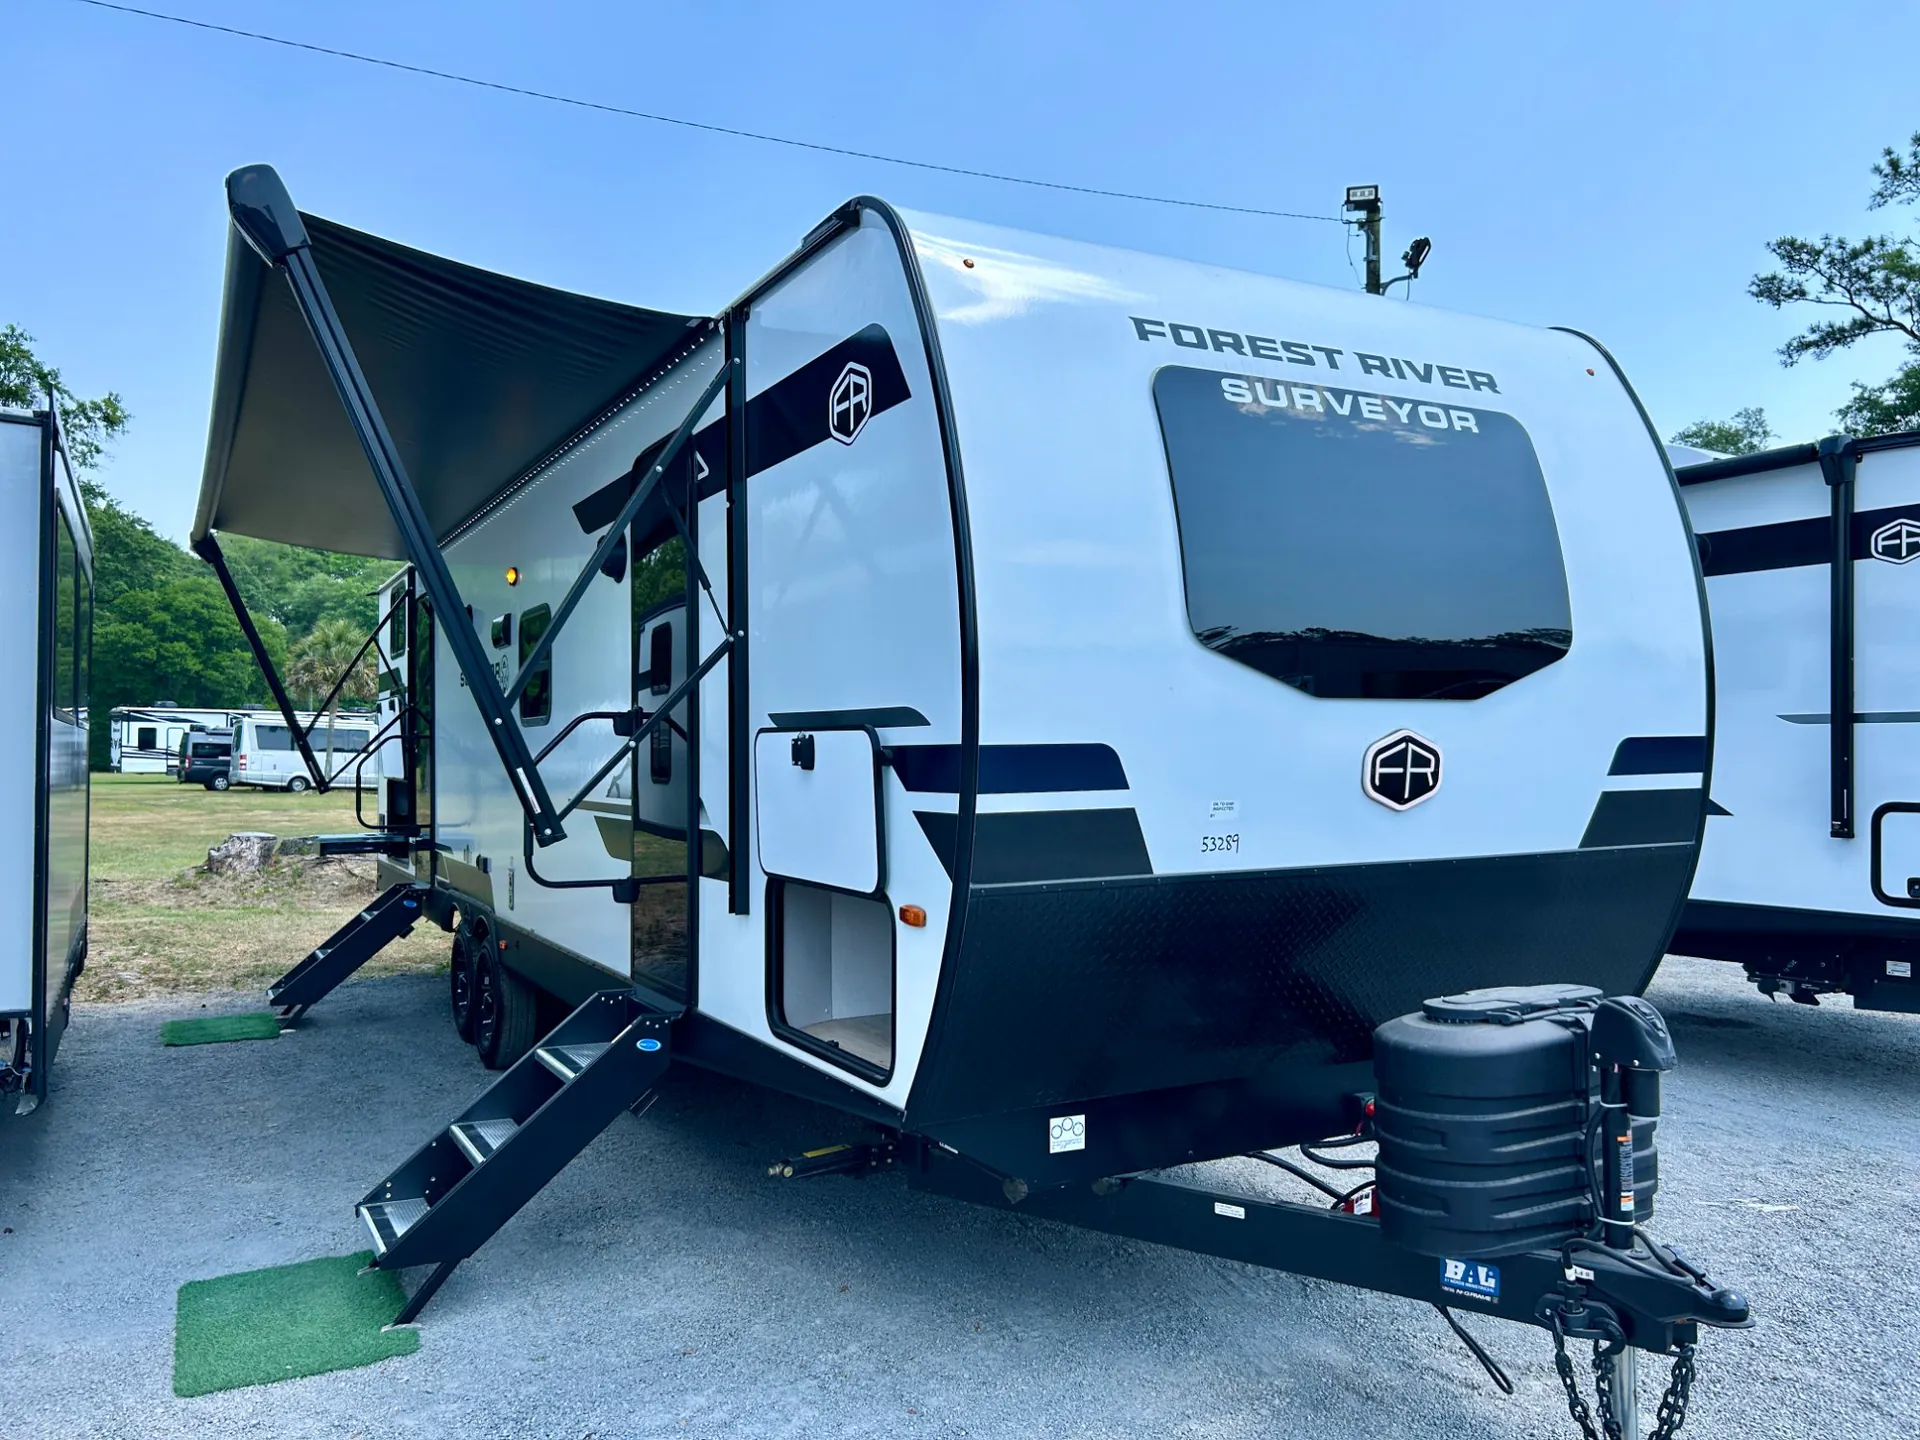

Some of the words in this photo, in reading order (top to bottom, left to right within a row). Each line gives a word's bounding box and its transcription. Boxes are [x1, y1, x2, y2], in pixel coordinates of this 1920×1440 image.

[1128, 316, 1344, 370] FOREST
[1353, 351, 1502, 395] RIVER
[1220, 377, 1480, 434] SURVEYOR
[1201, 833, 1240, 854] 53289
[1445, 1259, 1496, 1288] BAL
